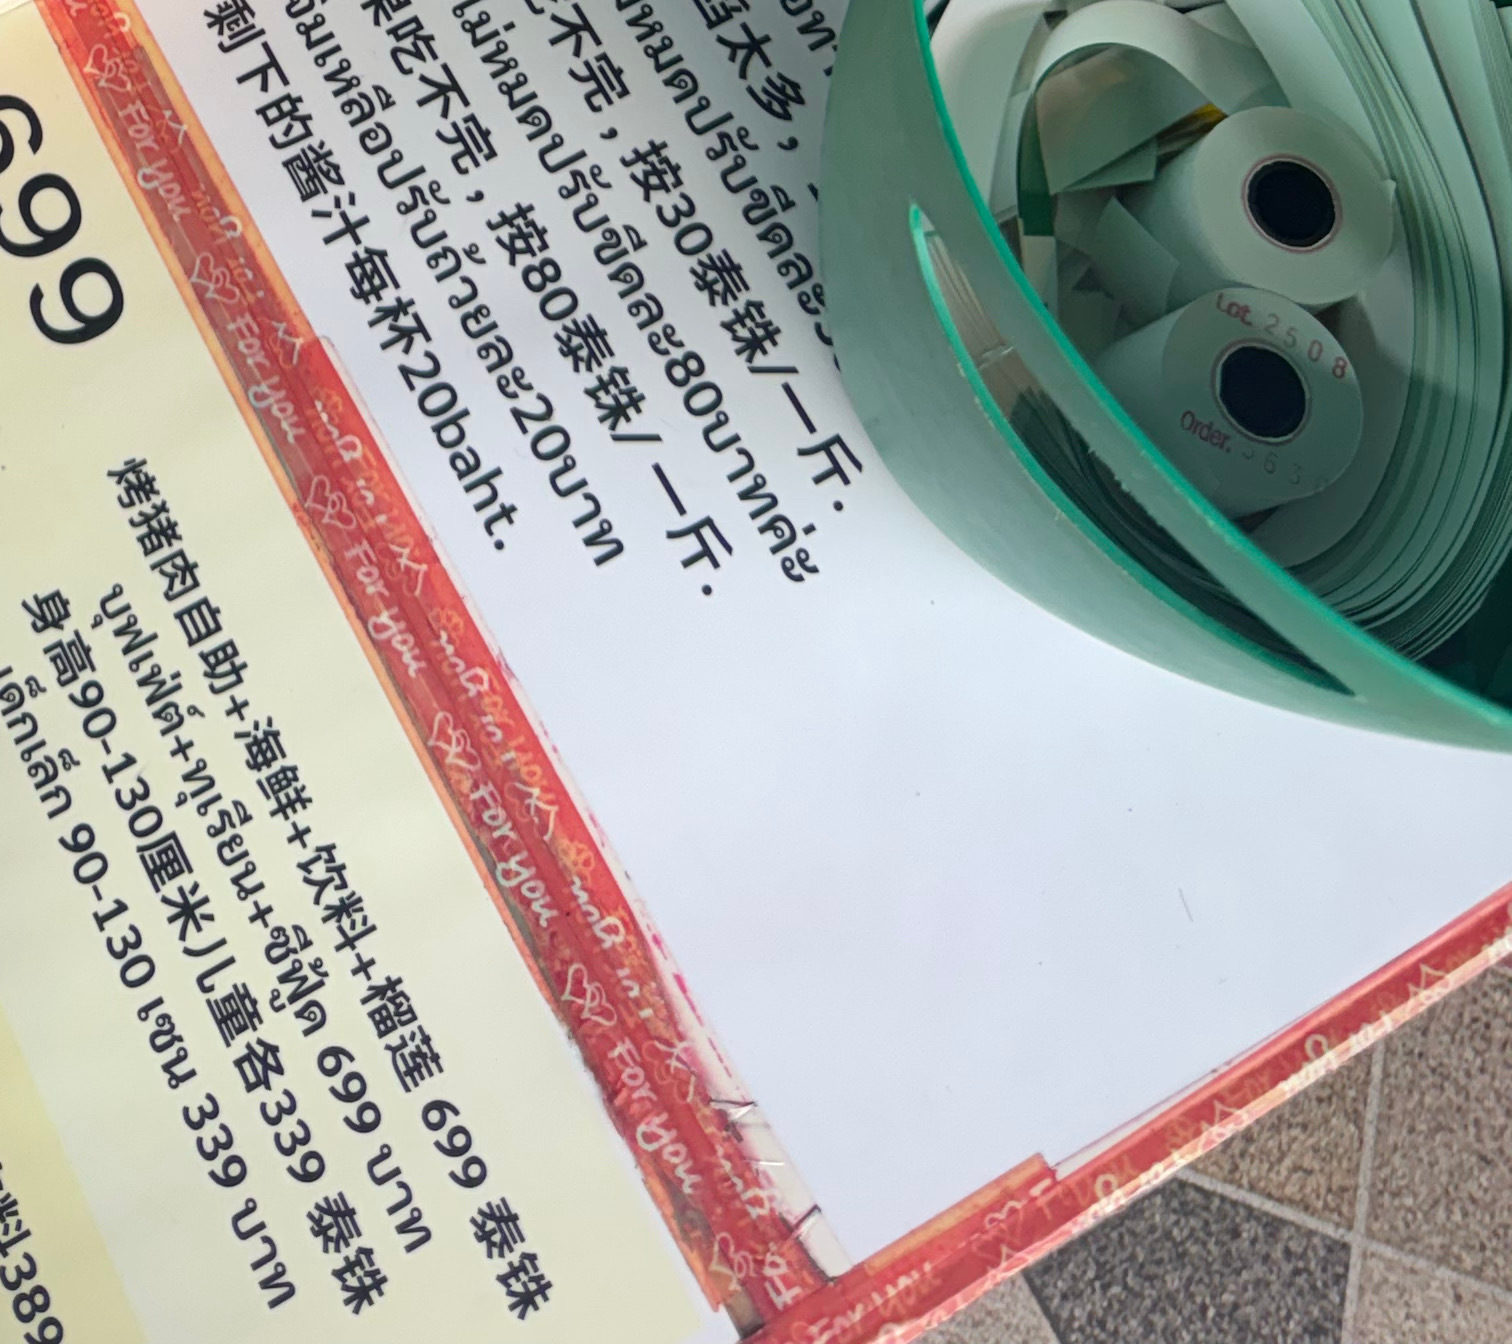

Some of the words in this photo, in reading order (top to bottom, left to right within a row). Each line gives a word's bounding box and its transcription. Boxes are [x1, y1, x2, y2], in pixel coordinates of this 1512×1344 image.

[111, 95, 168, 166] For
[132, 159, 196, 230] you
[222, 310, 280, 386] For
[246, 379, 312, 450] you
[1179, 409, 1232, 454] Order.
[342, 536, 400, 612] For
[364, 606, 436, 682] you
[468, 776, 528, 856] For
[106, 458, 444, 1093] 烤猪肉自助+海鲜+饮料+榴莲
[421, 1099, 488, 1189] 699
[469, 1196, 553, 1321] 泰铢
[493, 849, 568, 932] you
[21, 589, 326, 1184] 身高90-130厘米儿童各339
[306, 1191, 388, 1315] 泰铢
[58, 823, 156, 989] 90-130
[137, 996, 198, 1090] เซน
[182, 1092, 248, 1188] 339
[231, 1197, 296, 1310] บาท
[604, 1034, 663, 1114] For
[317, 1045, 382, 1134] 699
[367, 1143, 432, 1254] บาท
[629, 1108, 711, 1203] you
